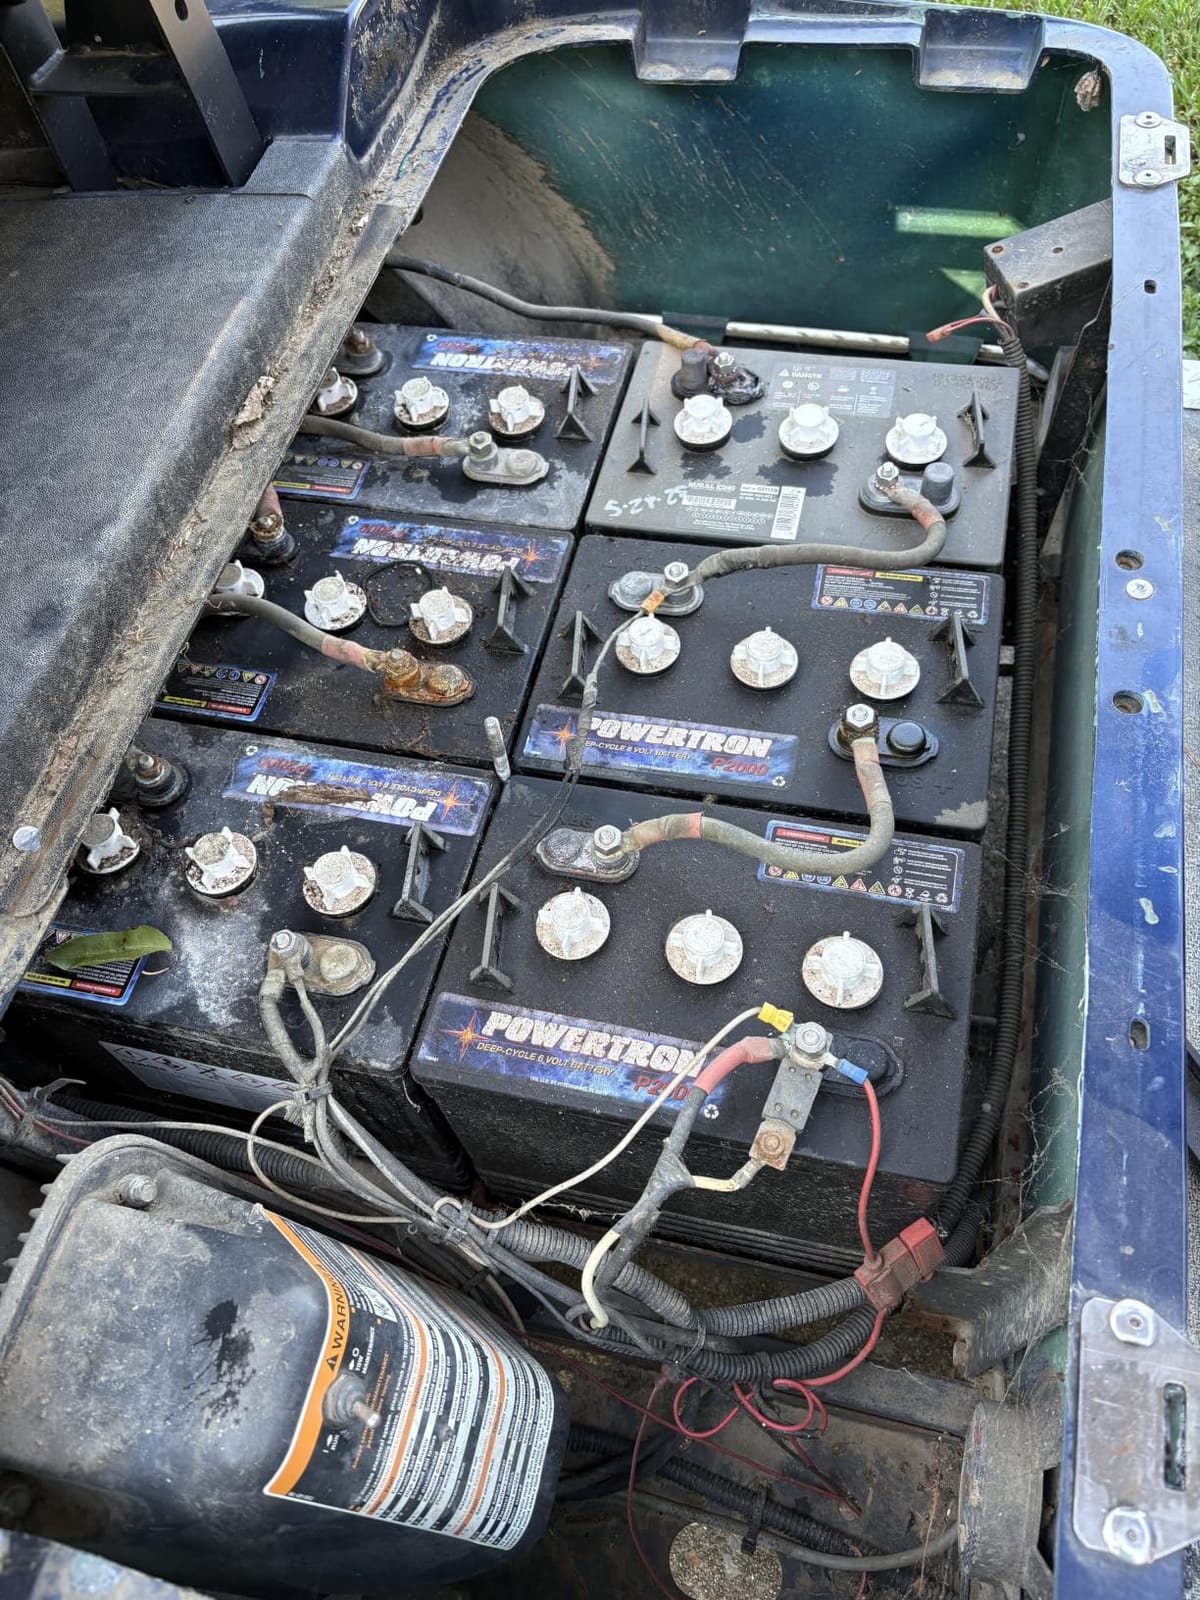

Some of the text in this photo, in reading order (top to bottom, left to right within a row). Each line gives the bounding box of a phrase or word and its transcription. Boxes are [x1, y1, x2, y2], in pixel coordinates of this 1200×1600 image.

[585, 740, 625, 752] EP-CYCLE
[633, 746, 654, 756] VOLT
[710, 758, 769, 777] P2000
[480, 1011, 707, 1078] POWERTRON
[476, 1041, 616, 1077] DEEP-CYCLE 6 VOLT BATTERY
[633, 1075, 689, 1101] P20
[361, 1325, 375, 1374] MAINTENANCE
[354, 1354, 364, 1372] TOW
[330, 1433, 339, 1450] RUN
